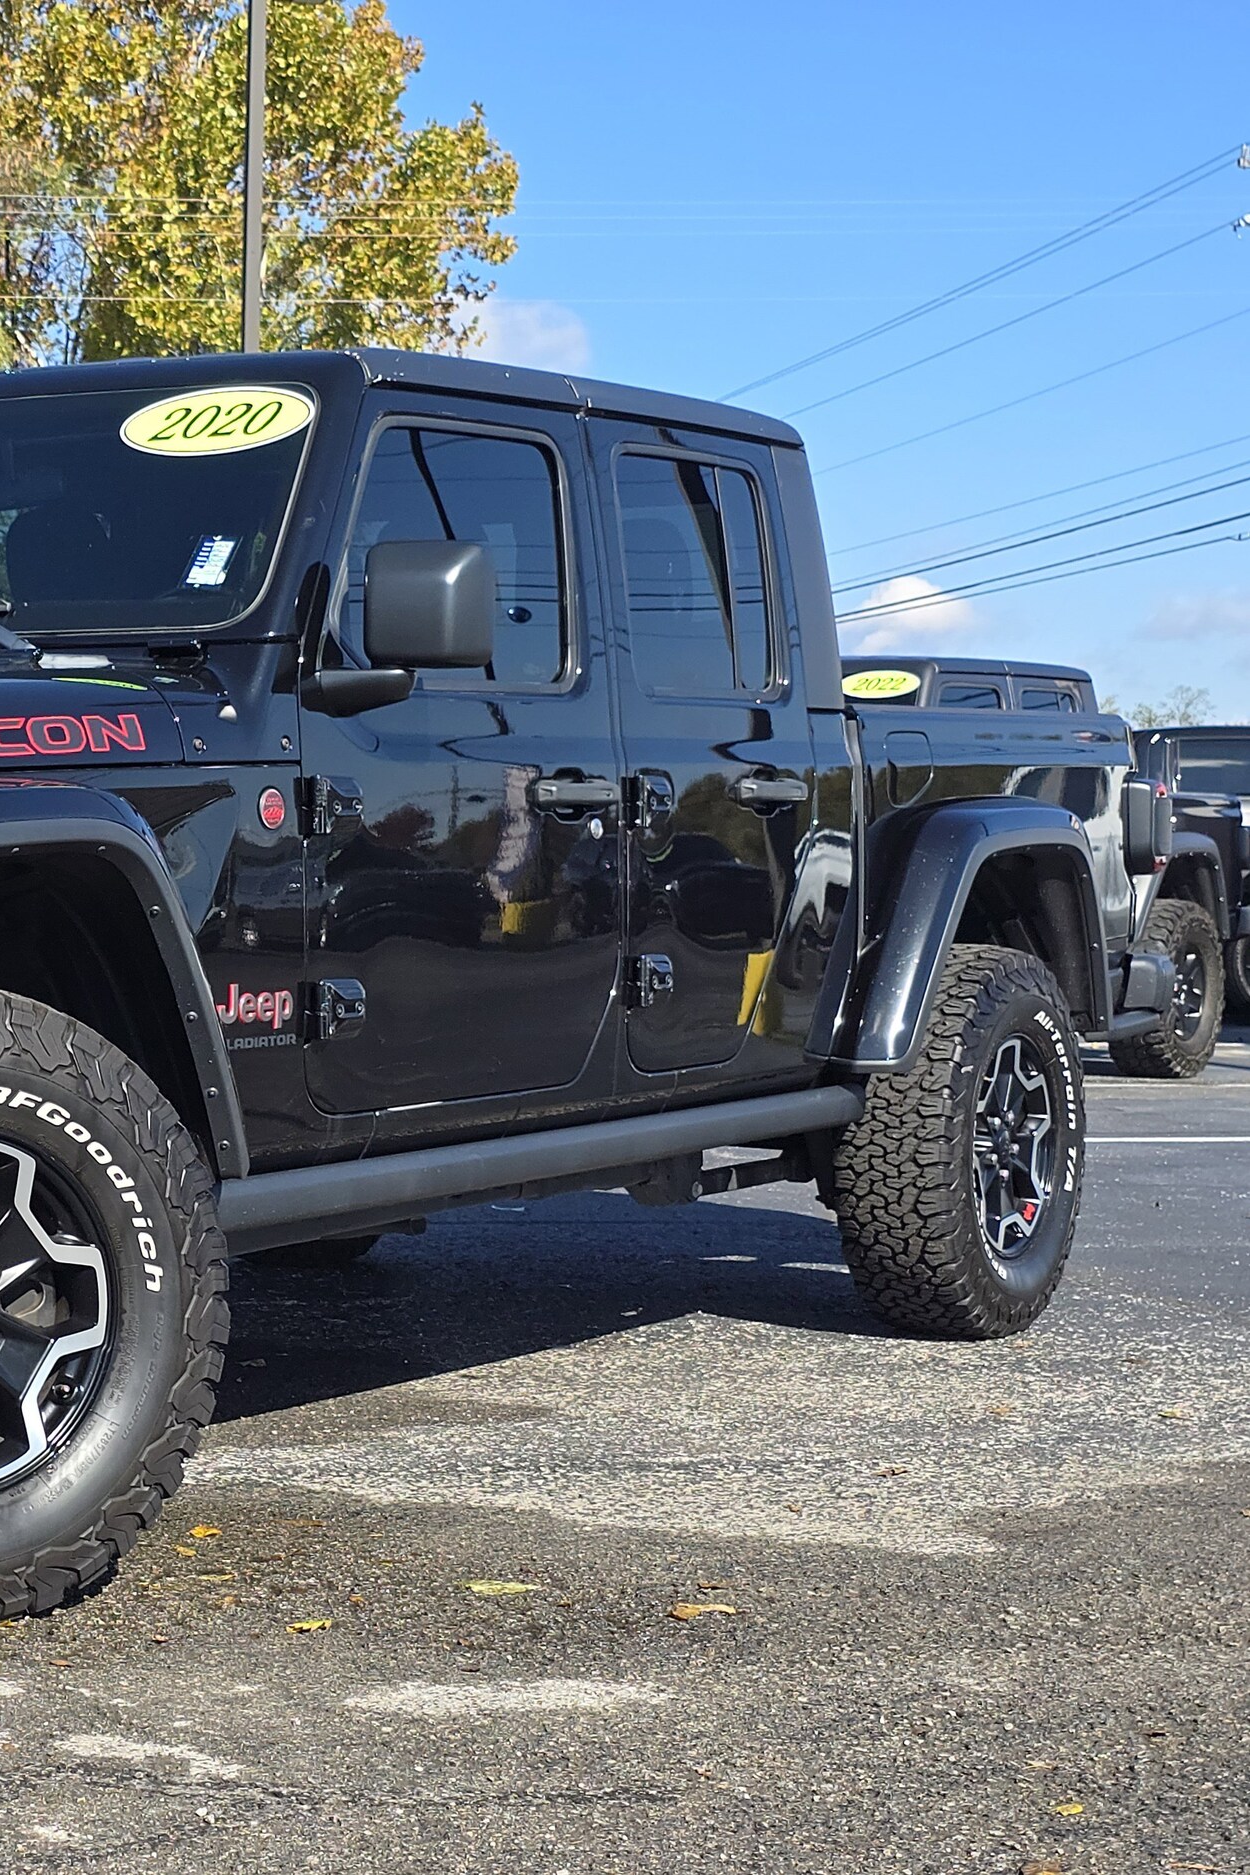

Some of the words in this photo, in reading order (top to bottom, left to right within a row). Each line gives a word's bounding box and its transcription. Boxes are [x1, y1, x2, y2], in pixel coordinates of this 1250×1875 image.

[147, 401, 283, 442] 2020
[852, 677, 907, 691] 2022
[216, 982, 294, 1029] Jeep
[225, 1032, 297, 1050] LADIATOR
[1033, 1010, 1077, 1130] All-Terrain
[1063, 1146, 1077, 1192] T/A
